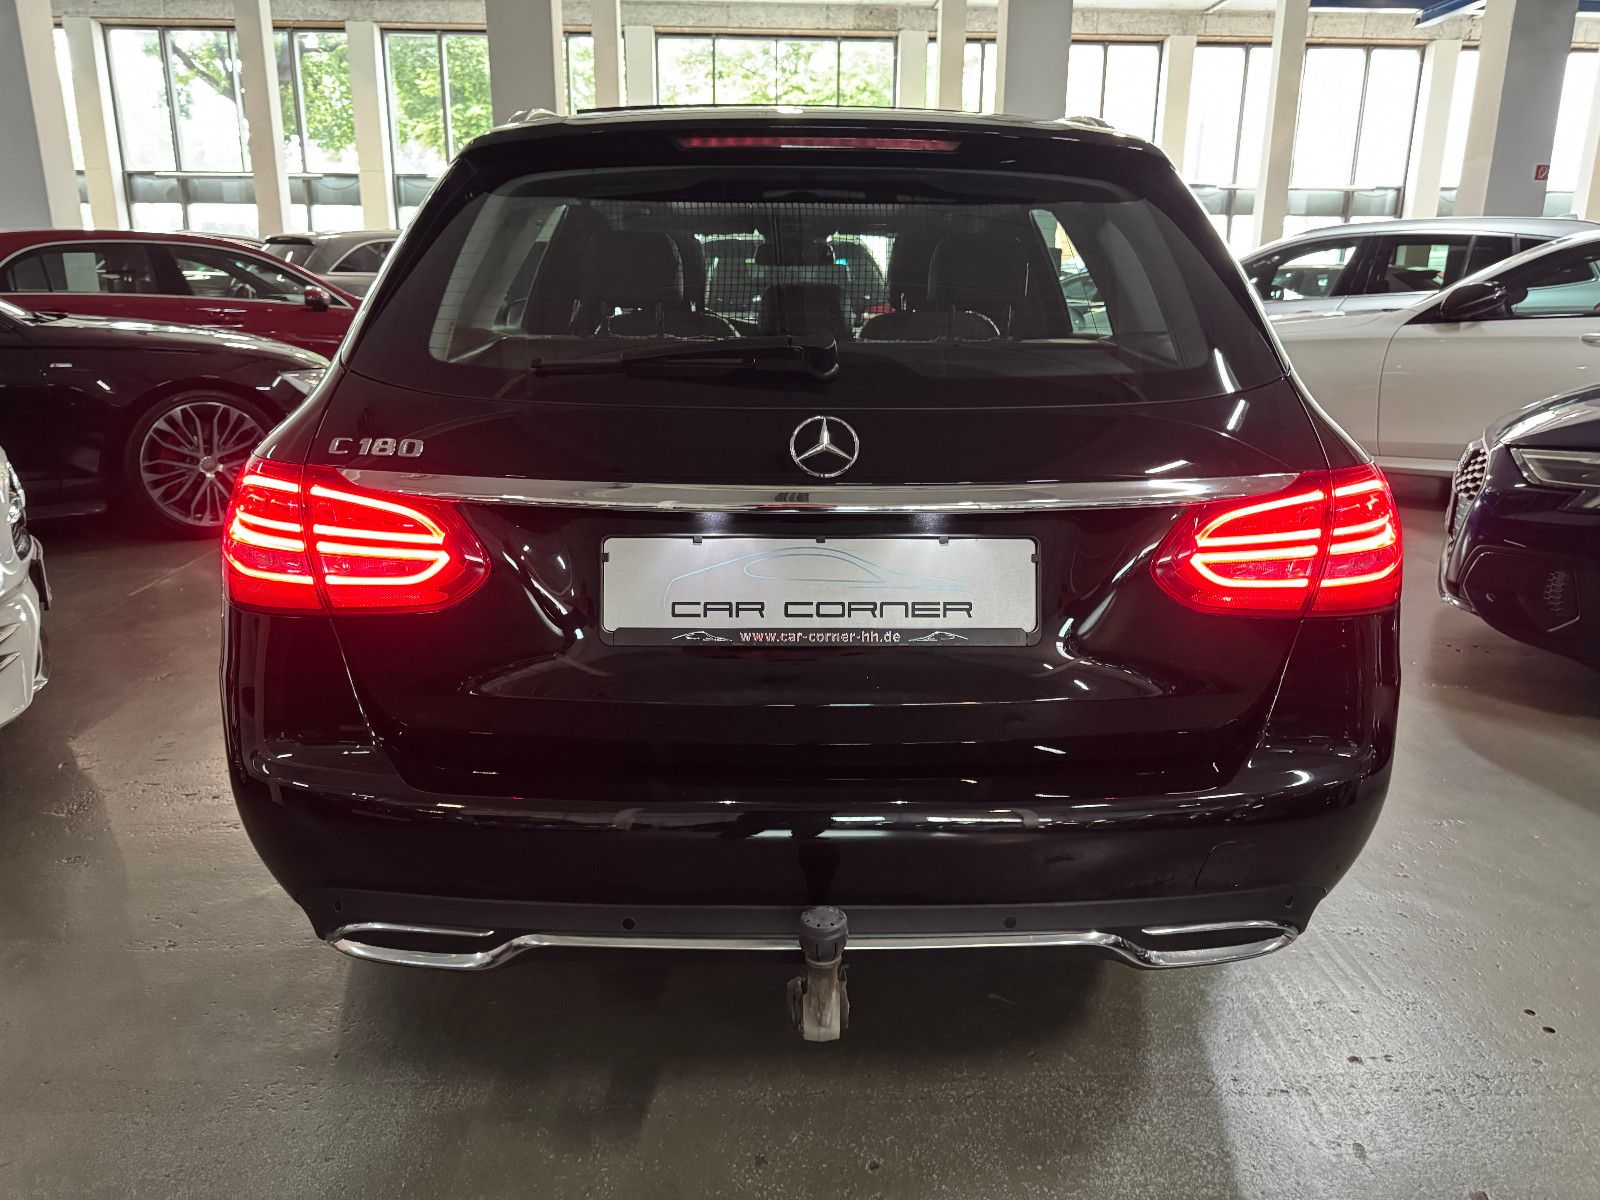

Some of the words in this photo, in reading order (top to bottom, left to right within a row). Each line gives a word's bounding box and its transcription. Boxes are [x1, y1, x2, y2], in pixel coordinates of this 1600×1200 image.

[328, 437, 353, 454] C
[358, 437, 424, 457] 180
[671, 601, 765, 618] CAR
[784, 601, 973, 618] CORNER
[739, 630, 901, 643] www.car-corner-hh.de
